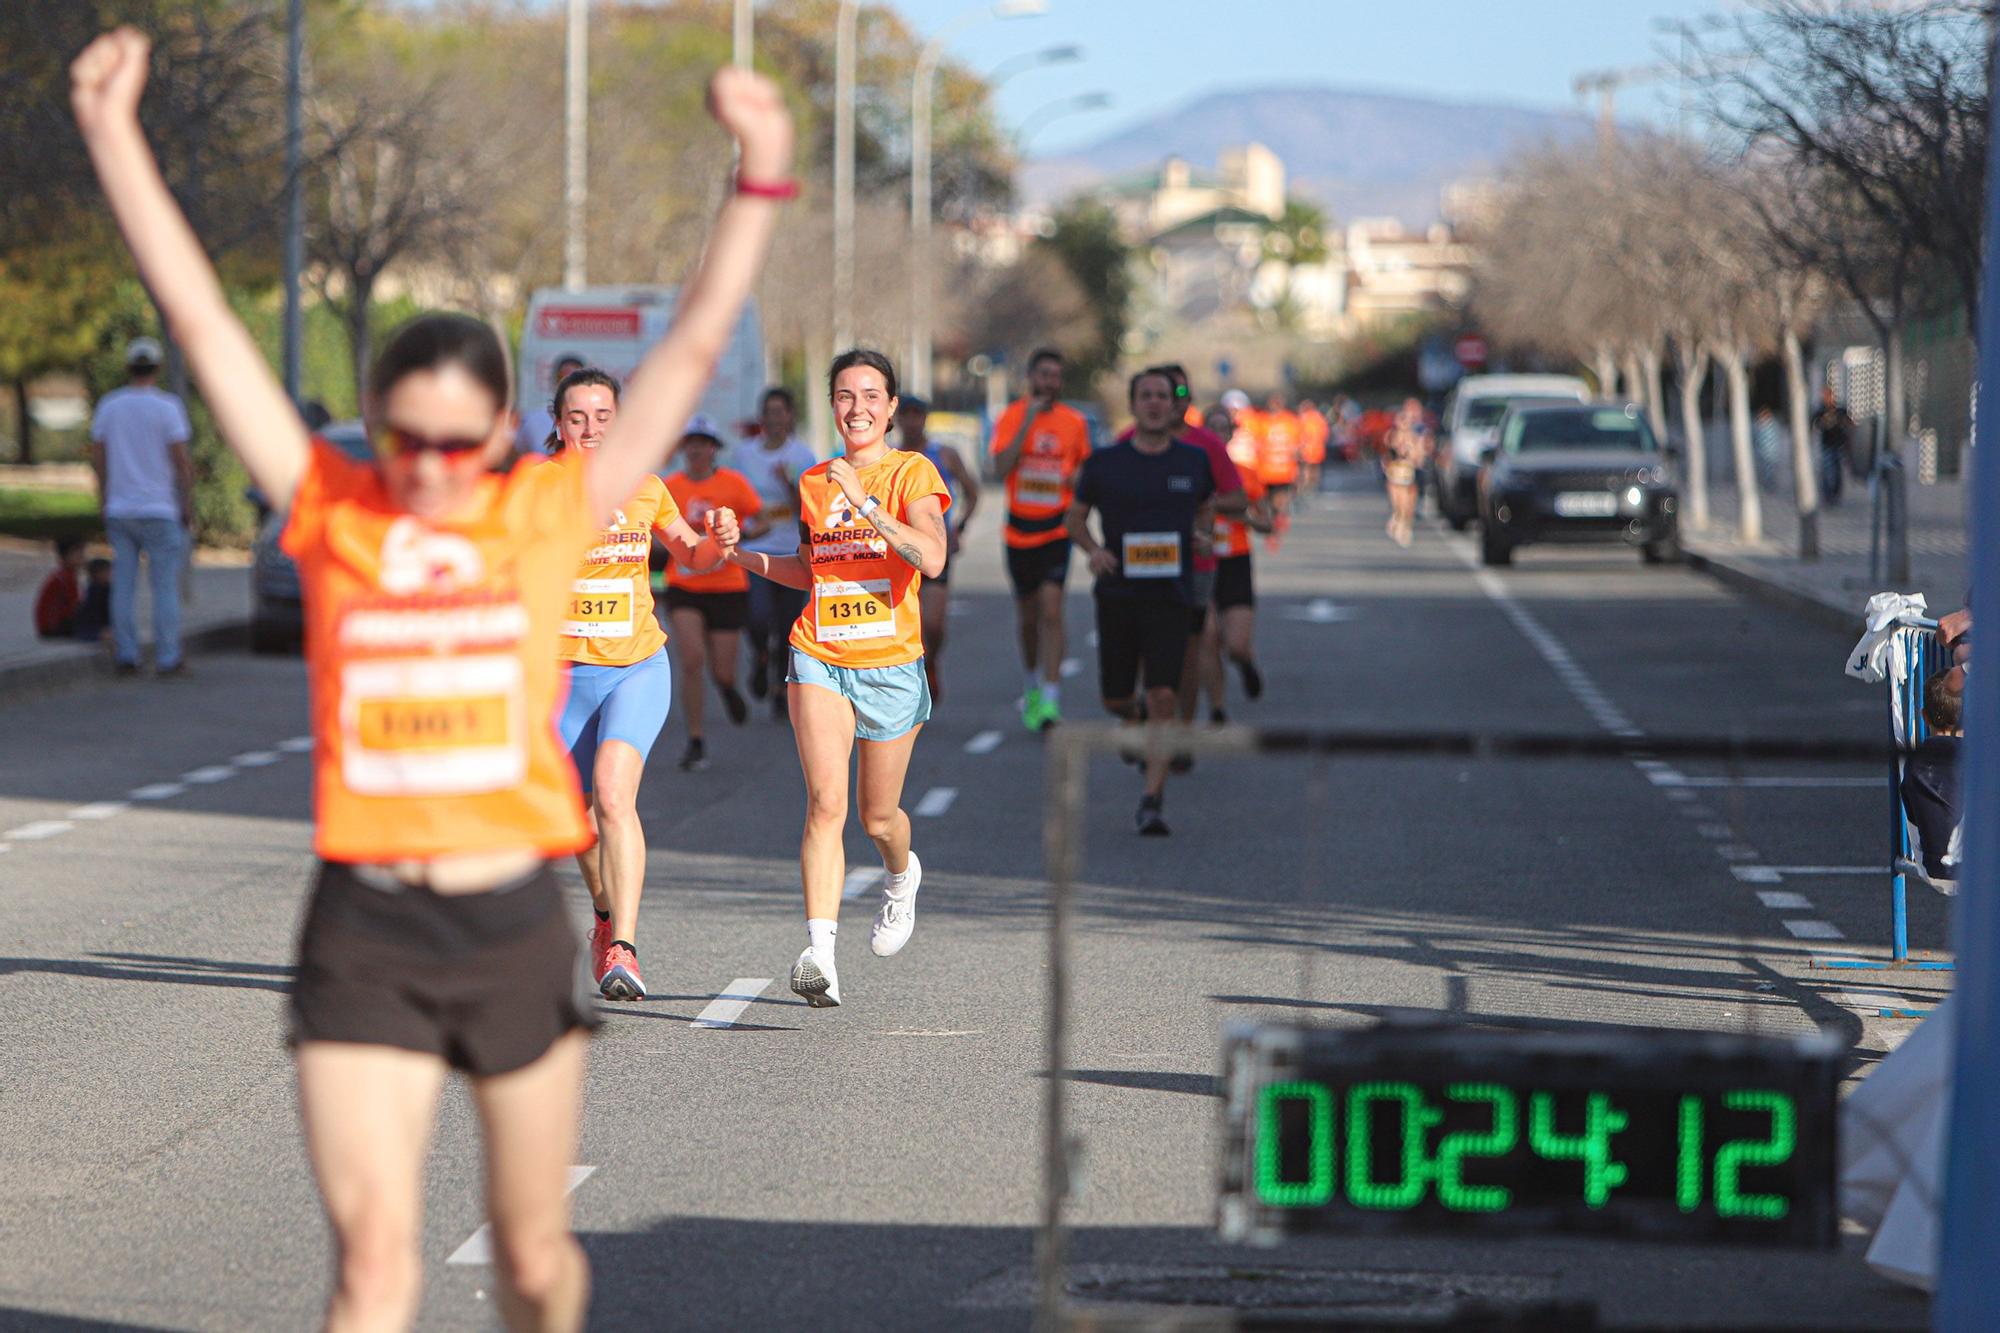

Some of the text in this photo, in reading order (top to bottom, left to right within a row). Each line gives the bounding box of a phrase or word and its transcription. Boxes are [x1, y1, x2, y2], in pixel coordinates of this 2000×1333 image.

[571, 600, 618, 615] 1317
[829, 601, 877, 618] 1316
[1256, 1081, 1797, 1218] 00:24:12
